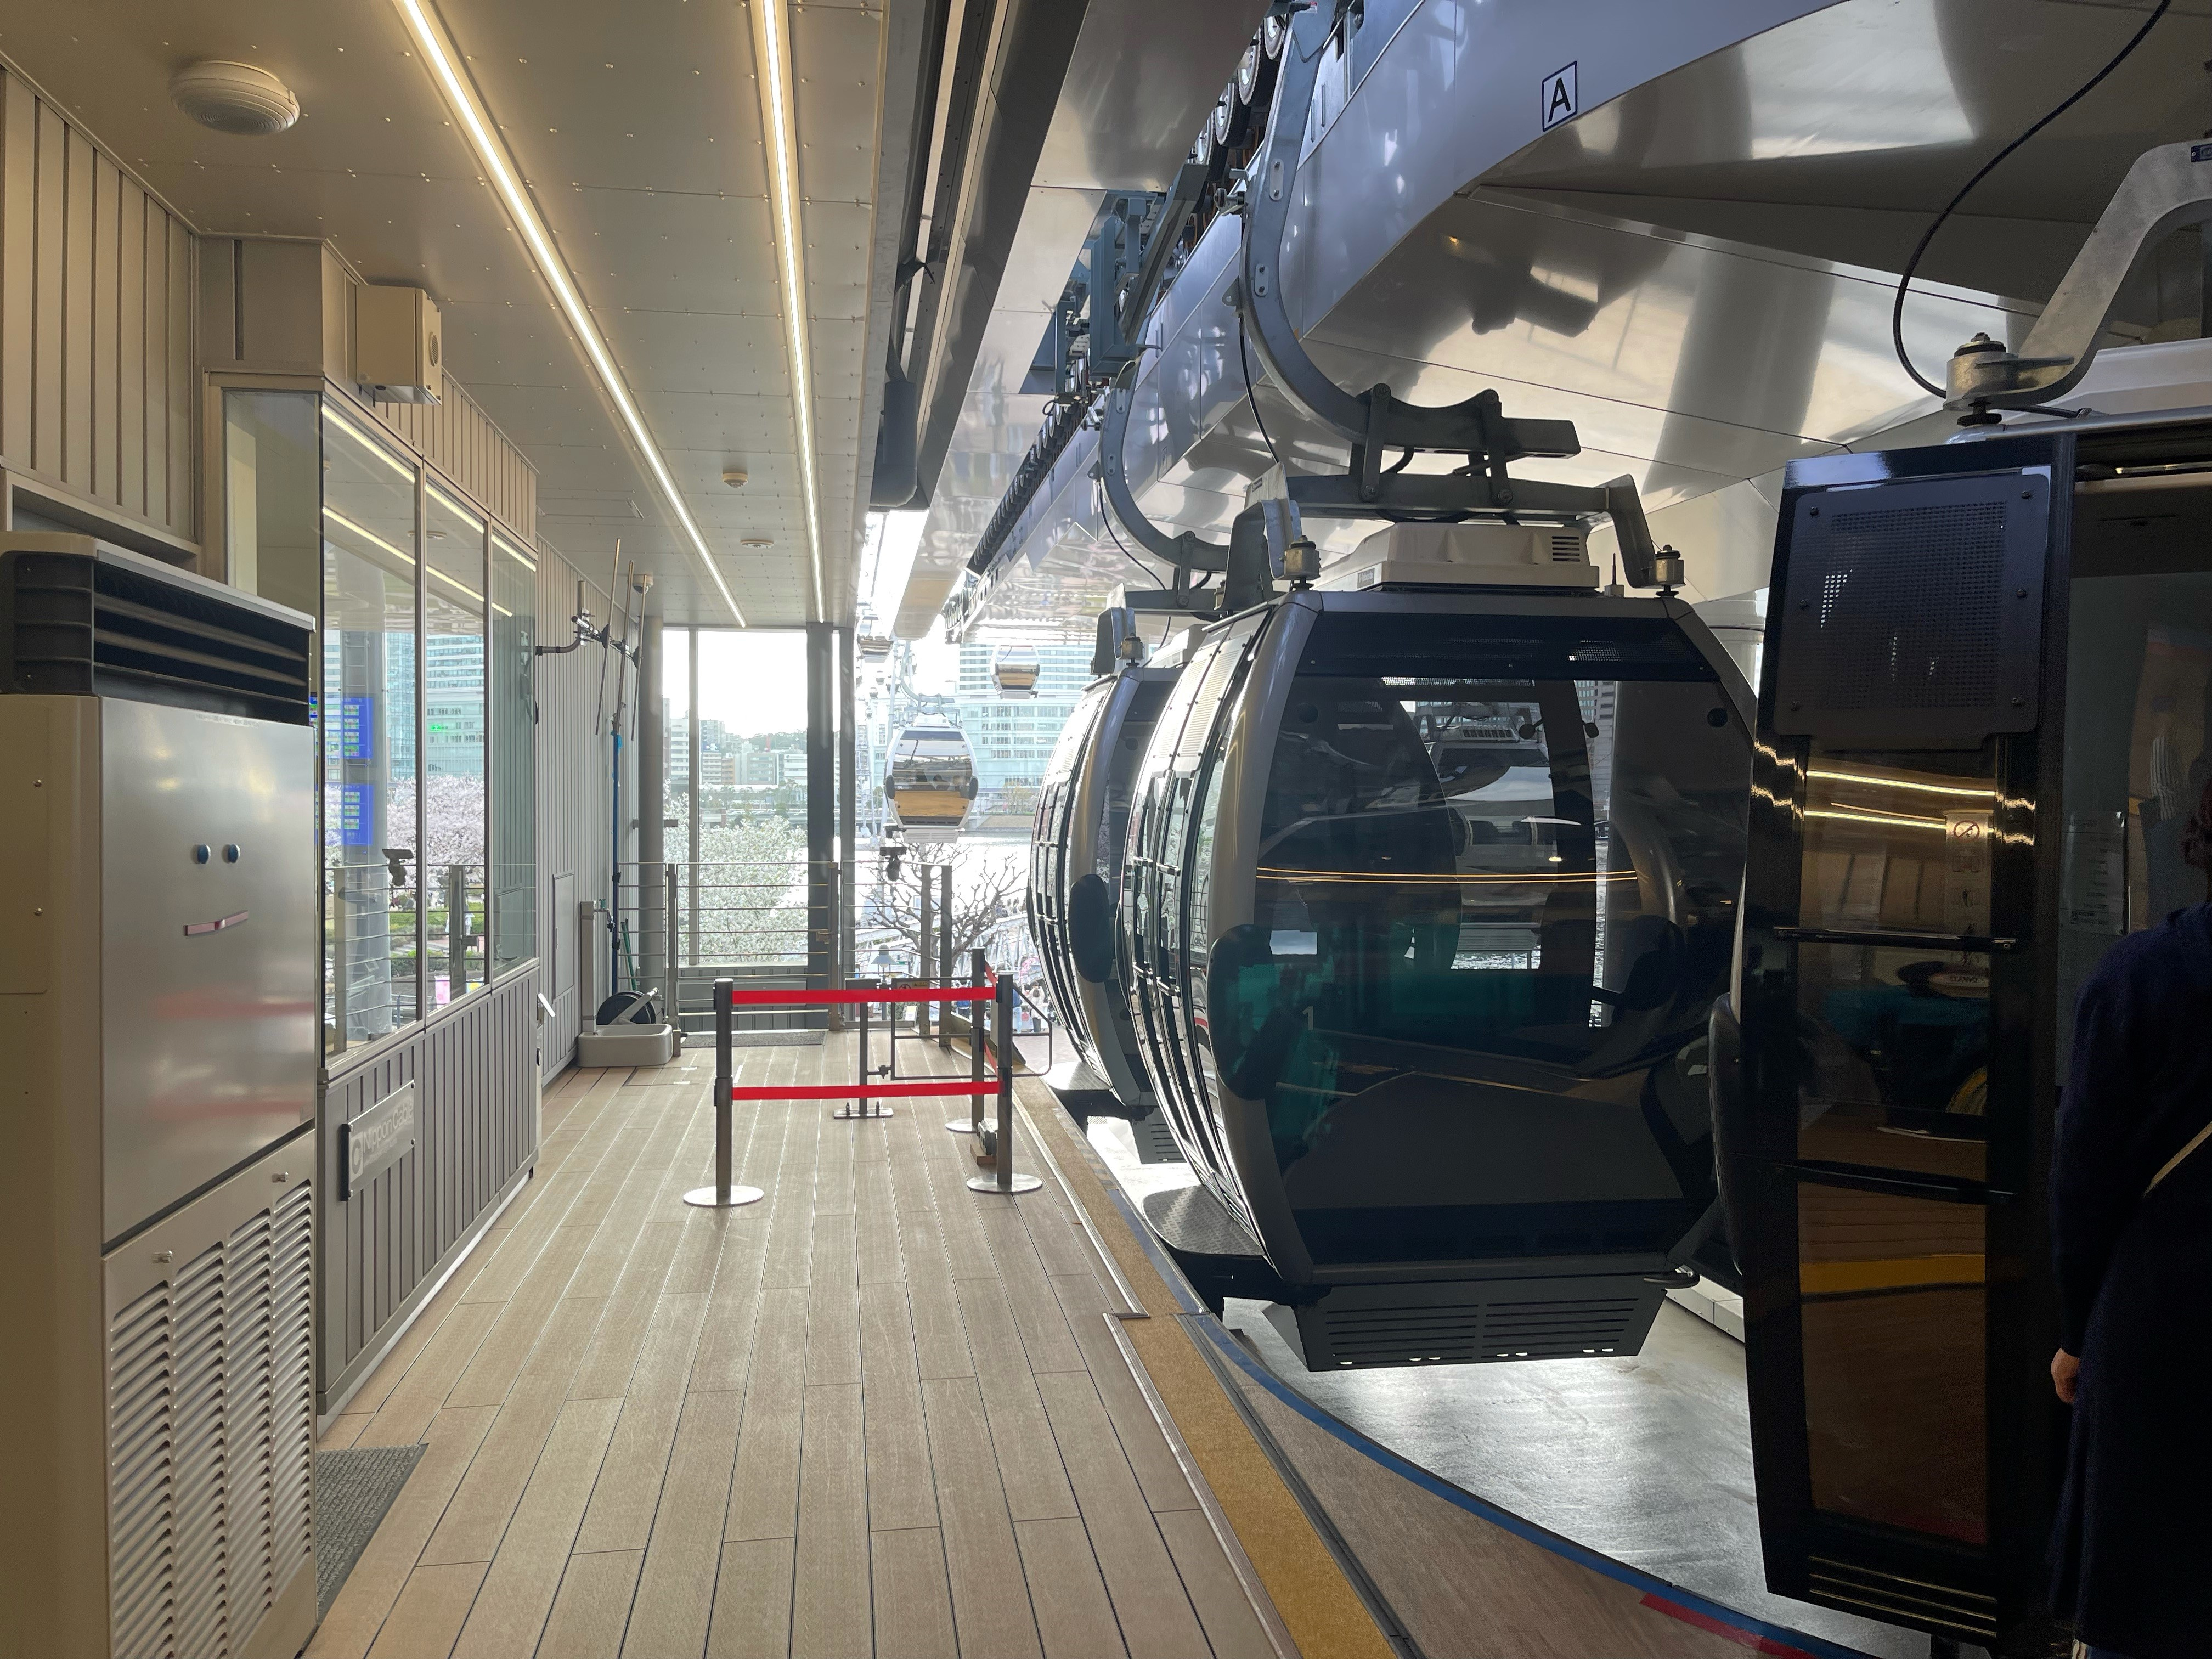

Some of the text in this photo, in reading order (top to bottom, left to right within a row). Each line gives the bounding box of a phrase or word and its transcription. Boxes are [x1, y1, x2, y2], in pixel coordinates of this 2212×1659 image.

[1548, 77, 1571, 122] A
[1302, 1006, 1314, 1030] 1
[363, 1119, 392, 1153] Nippon
[393, 1102, 414, 1129] Cable
